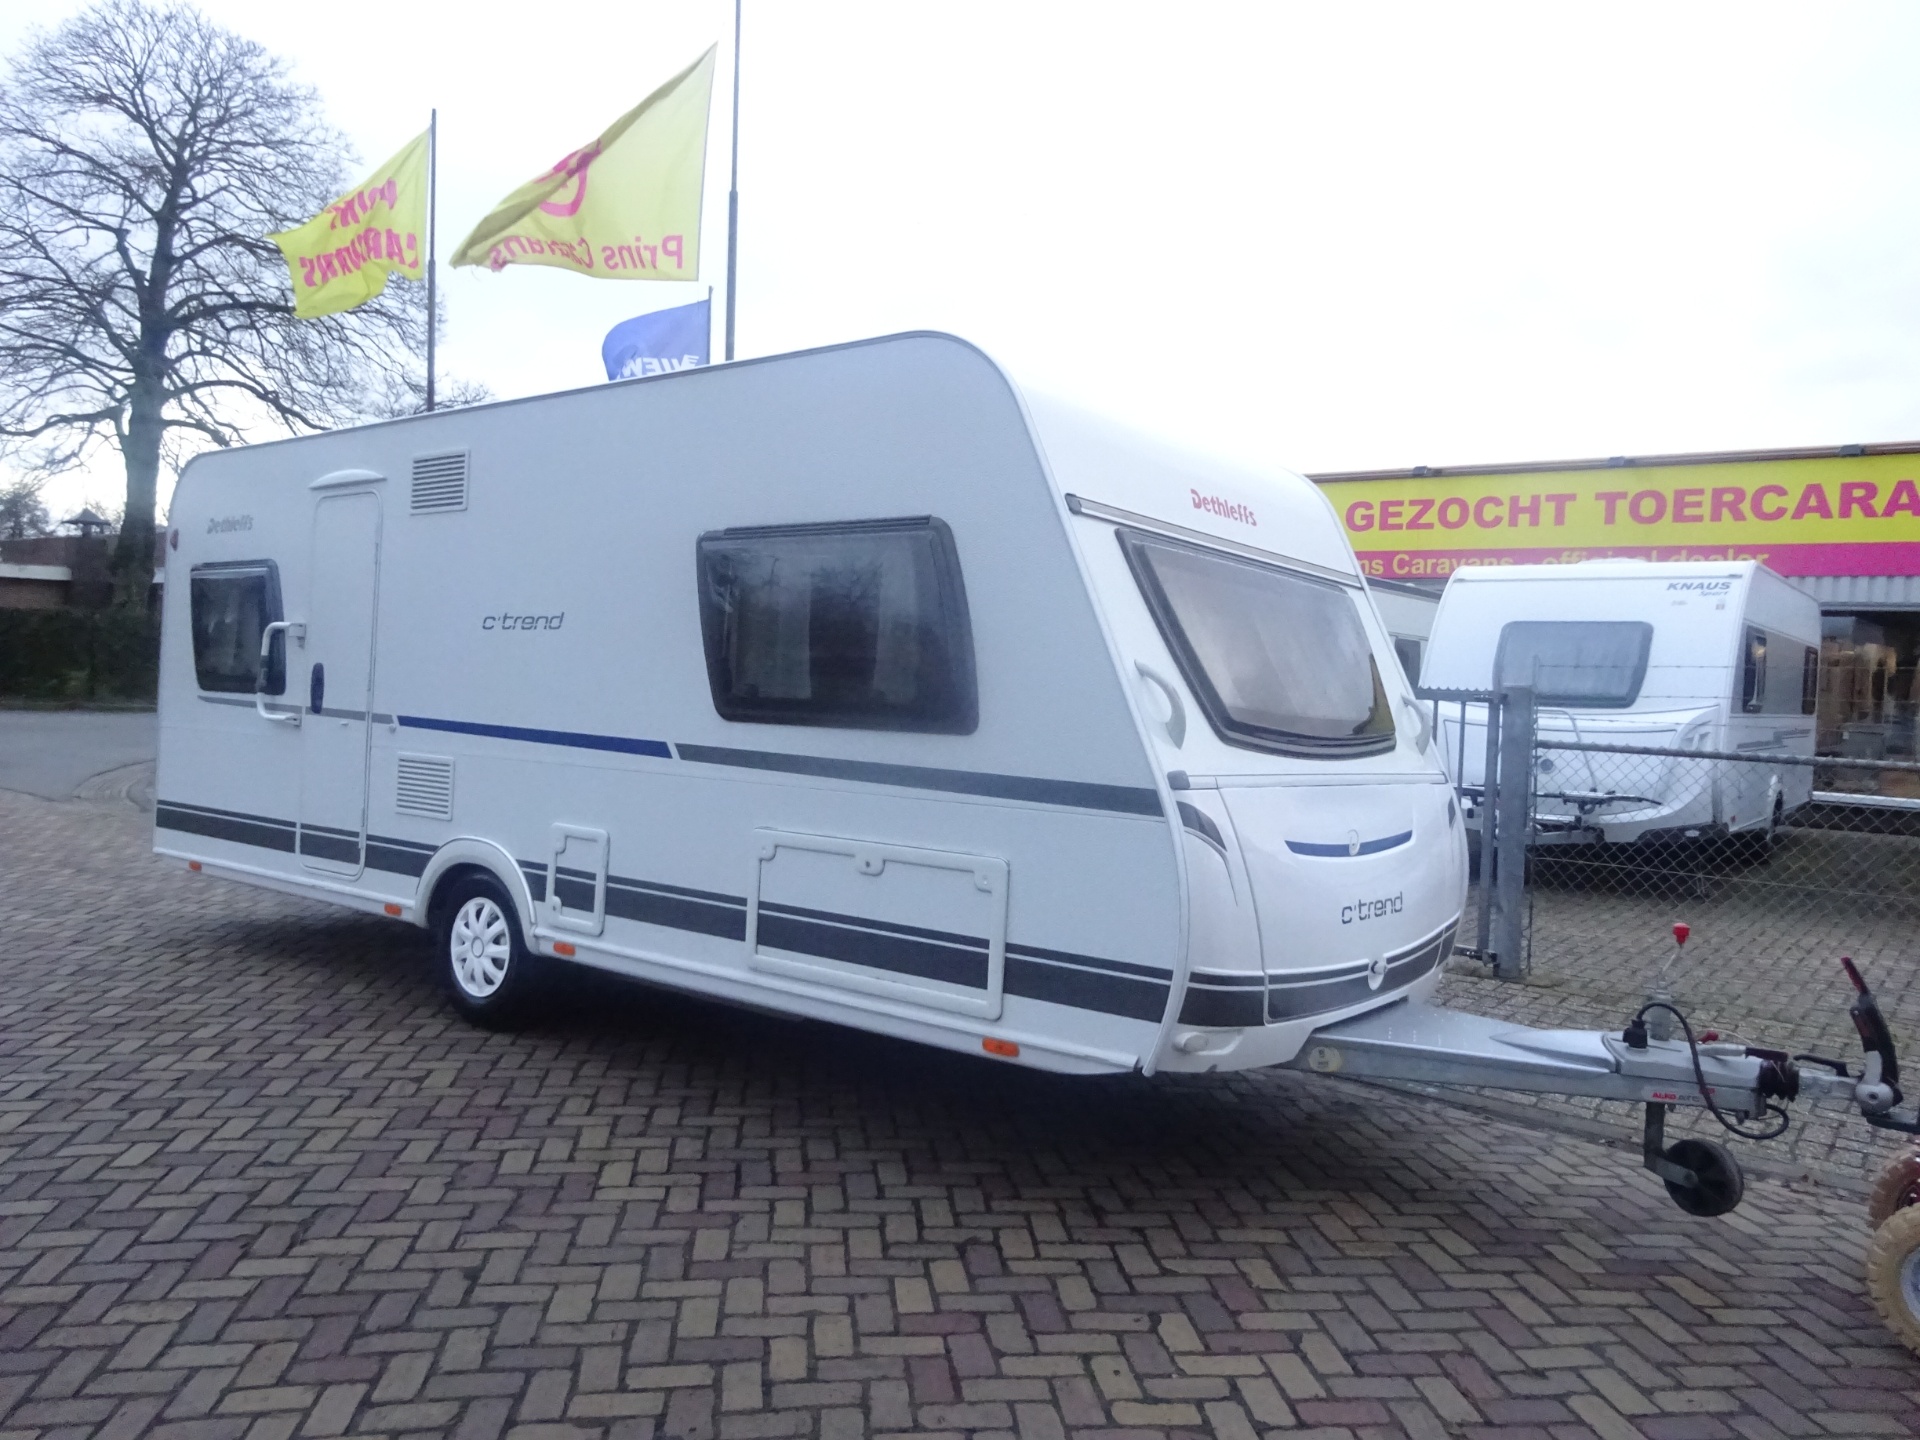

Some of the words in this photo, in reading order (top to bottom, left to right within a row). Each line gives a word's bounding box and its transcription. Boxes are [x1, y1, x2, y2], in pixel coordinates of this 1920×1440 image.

[1190, 488, 1257, 527] Dethleffs
[1346, 493, 1577, 532] GEZOCHT
[1595, 479, 1920, 526] TOERCARA
[1666, 581, 1732, 591] KNAUS
